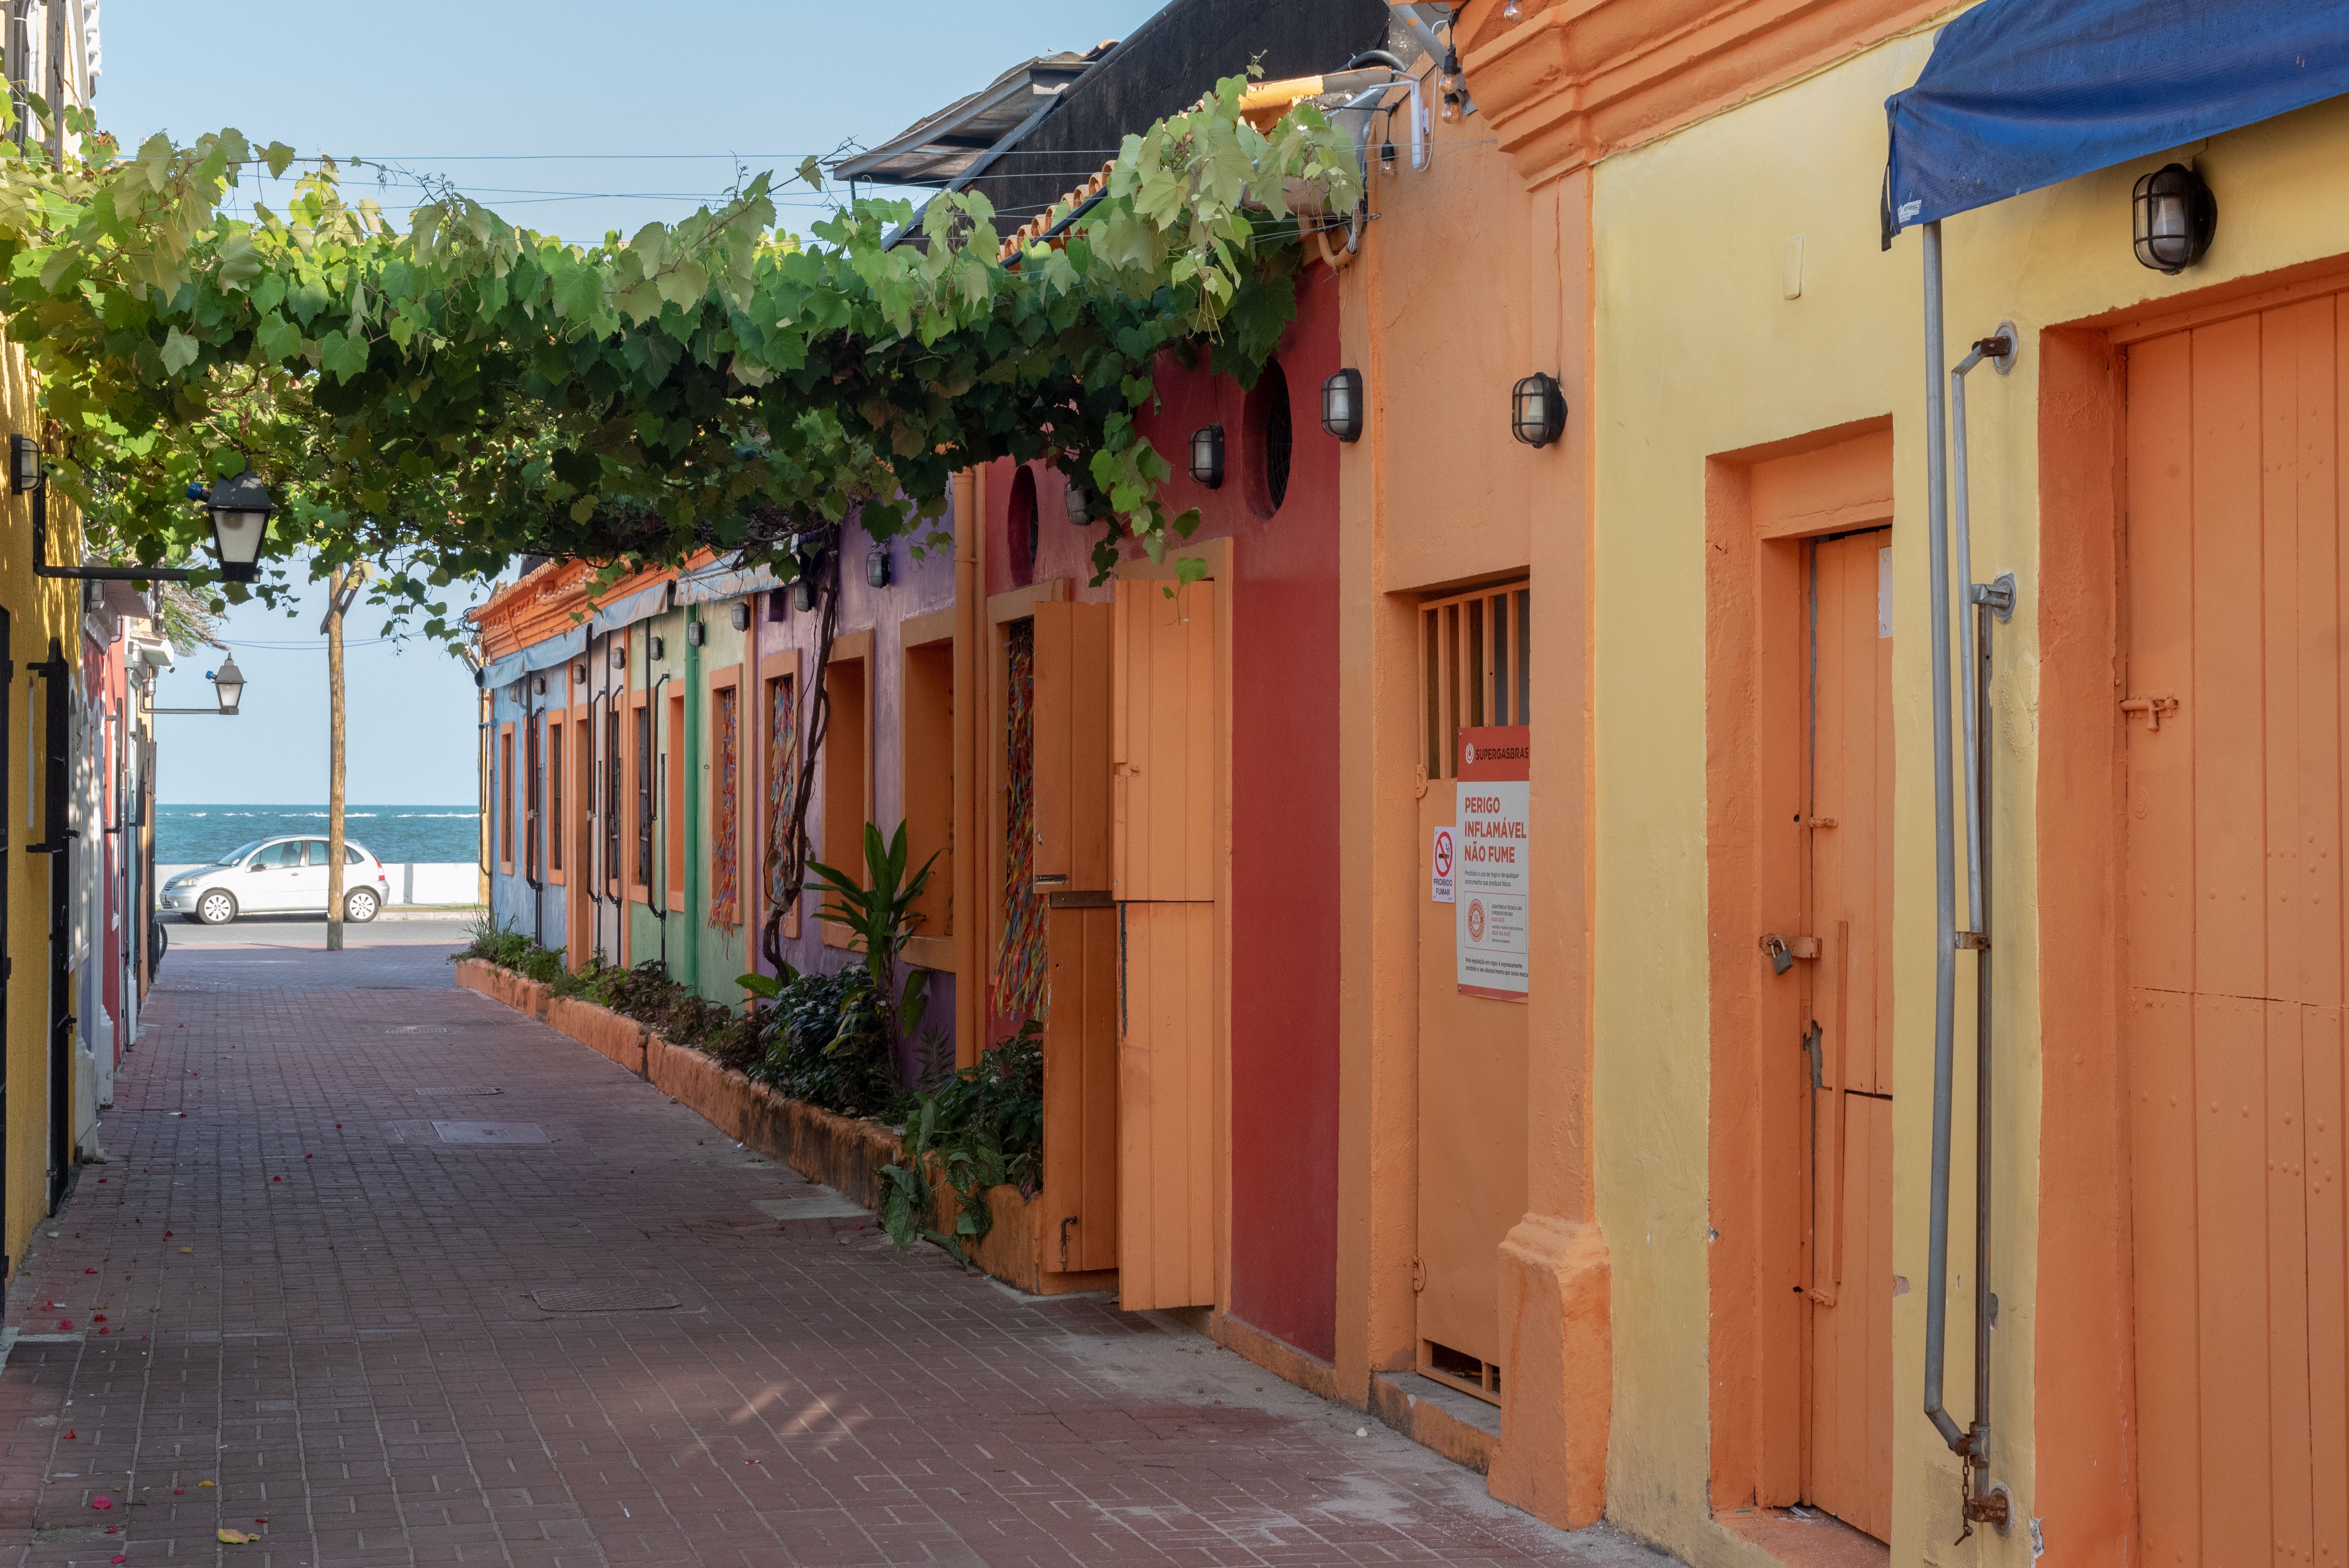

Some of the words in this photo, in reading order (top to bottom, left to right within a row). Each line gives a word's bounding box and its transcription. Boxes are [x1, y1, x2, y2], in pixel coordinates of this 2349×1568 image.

[1476, 747, 1529, 760] SUPERGASBRAS
[1465, 796, 1500, 813] PERIGO
[1464, 817, 1527, 839] INFLAMÁVEL
[1464, 841, 1486, 862] NÃO
[1488, 846, 1515, 863] FUME
